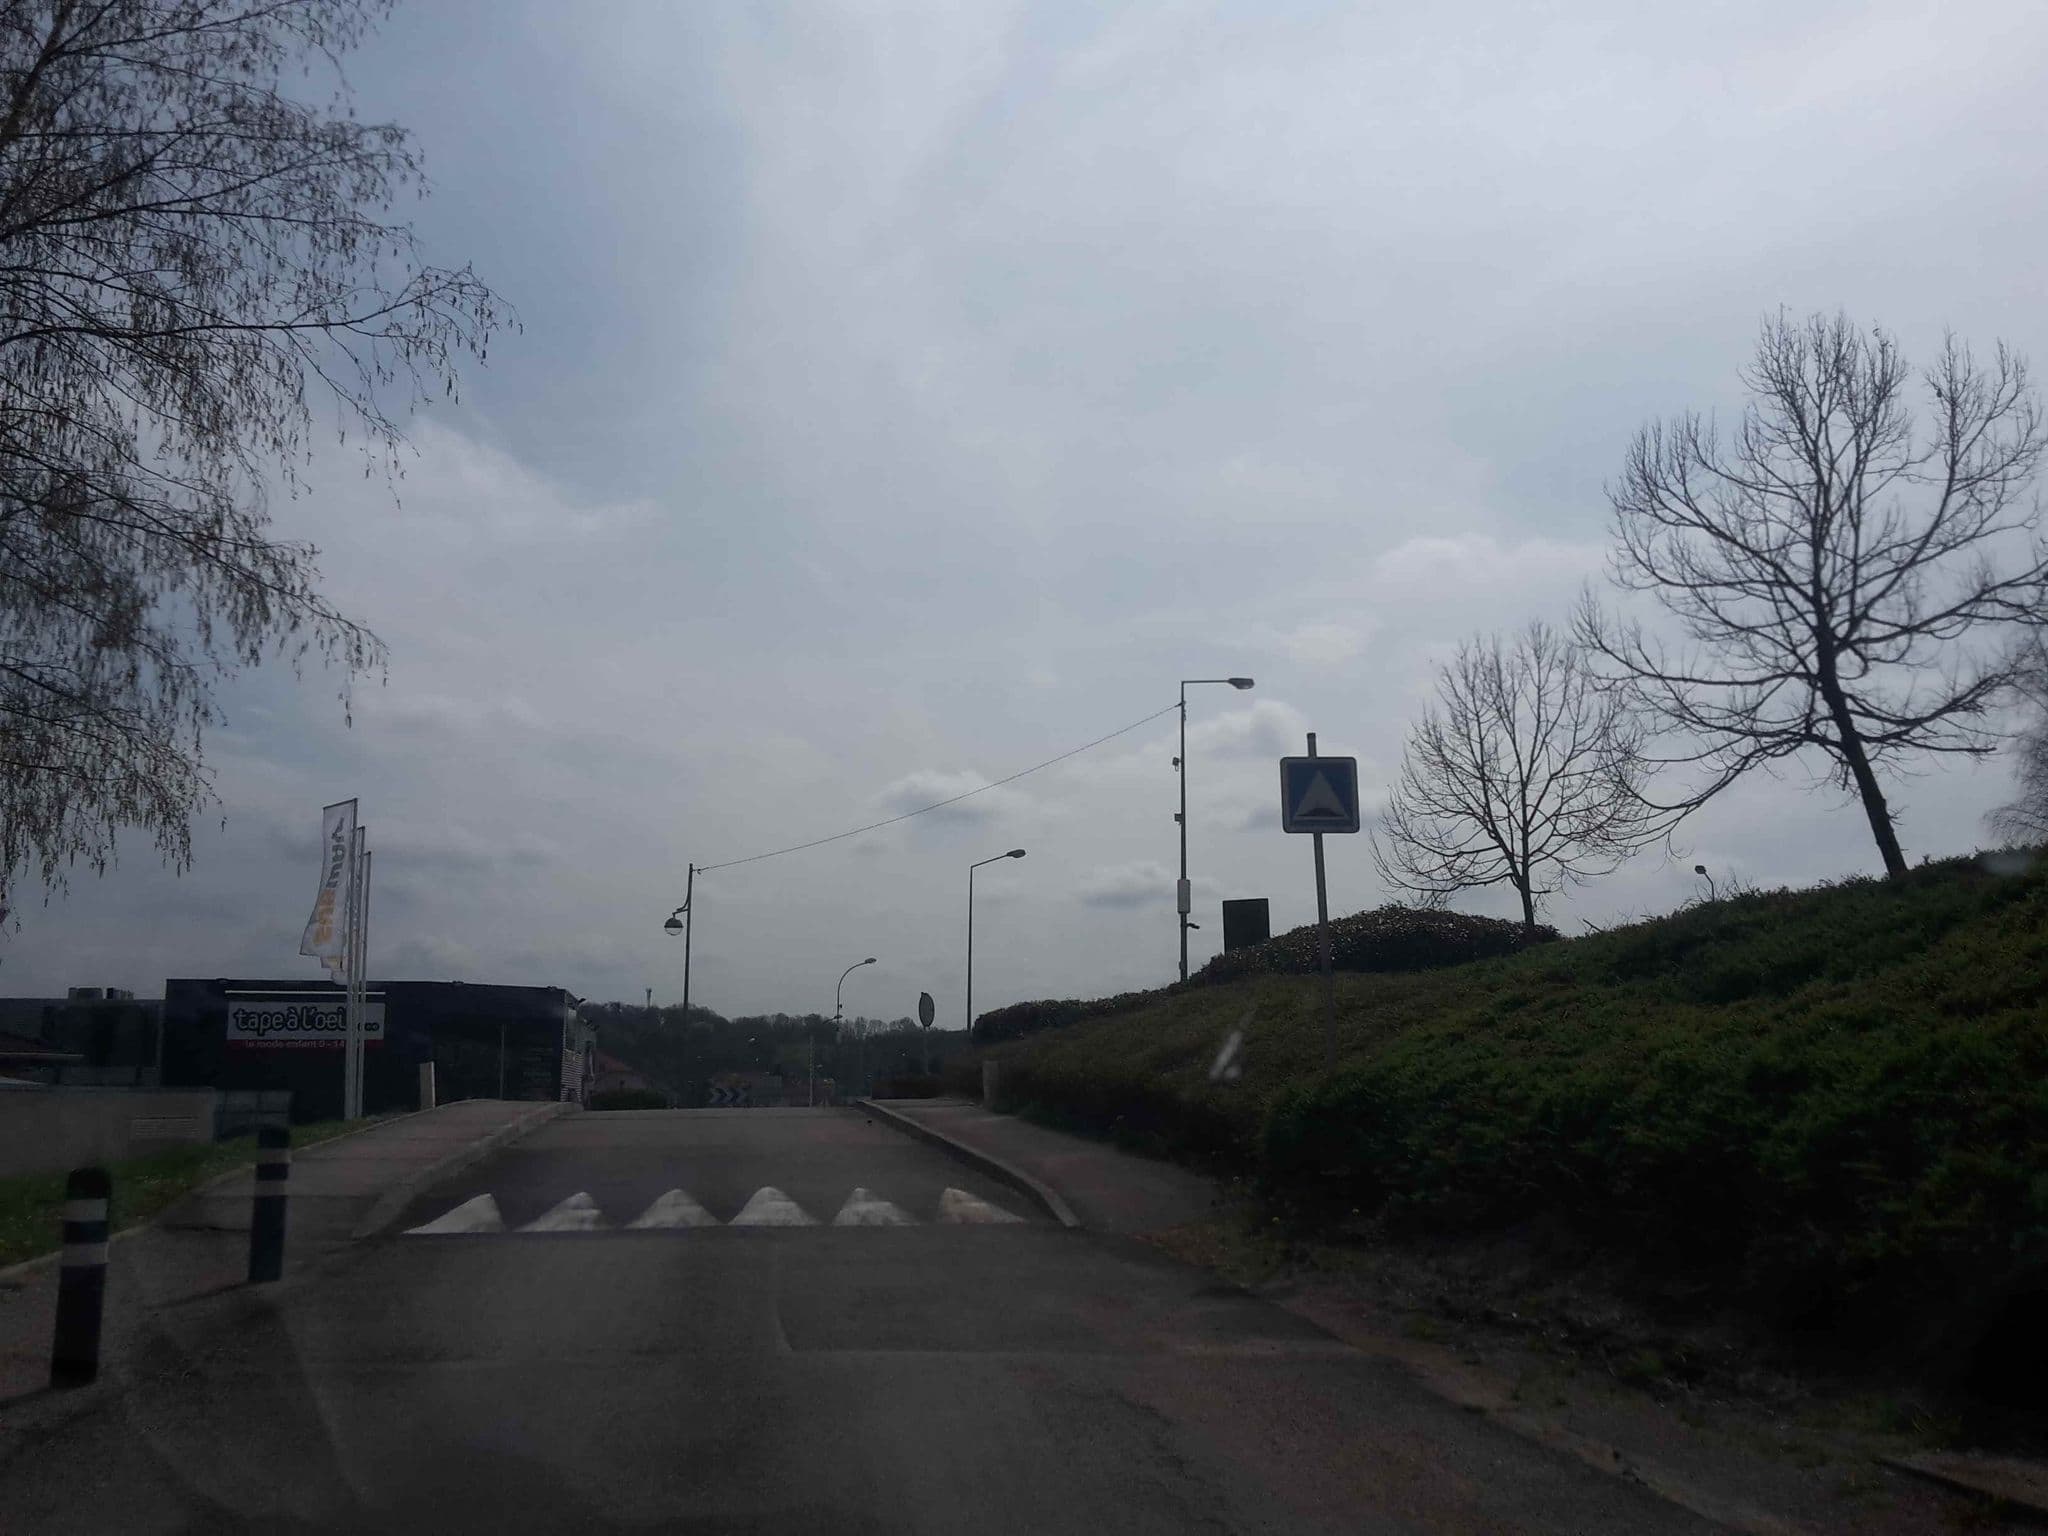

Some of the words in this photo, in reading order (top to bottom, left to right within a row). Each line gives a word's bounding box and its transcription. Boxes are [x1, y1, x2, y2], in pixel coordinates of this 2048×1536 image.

[233, 1007, 284, 1036] tape
[285, 1006, 299, 1032] à
[301, 1006, 350, 1032] l'oei
[256, 1039, 285, 1048] mode
[286, 1039, 317, 1048] enfant
